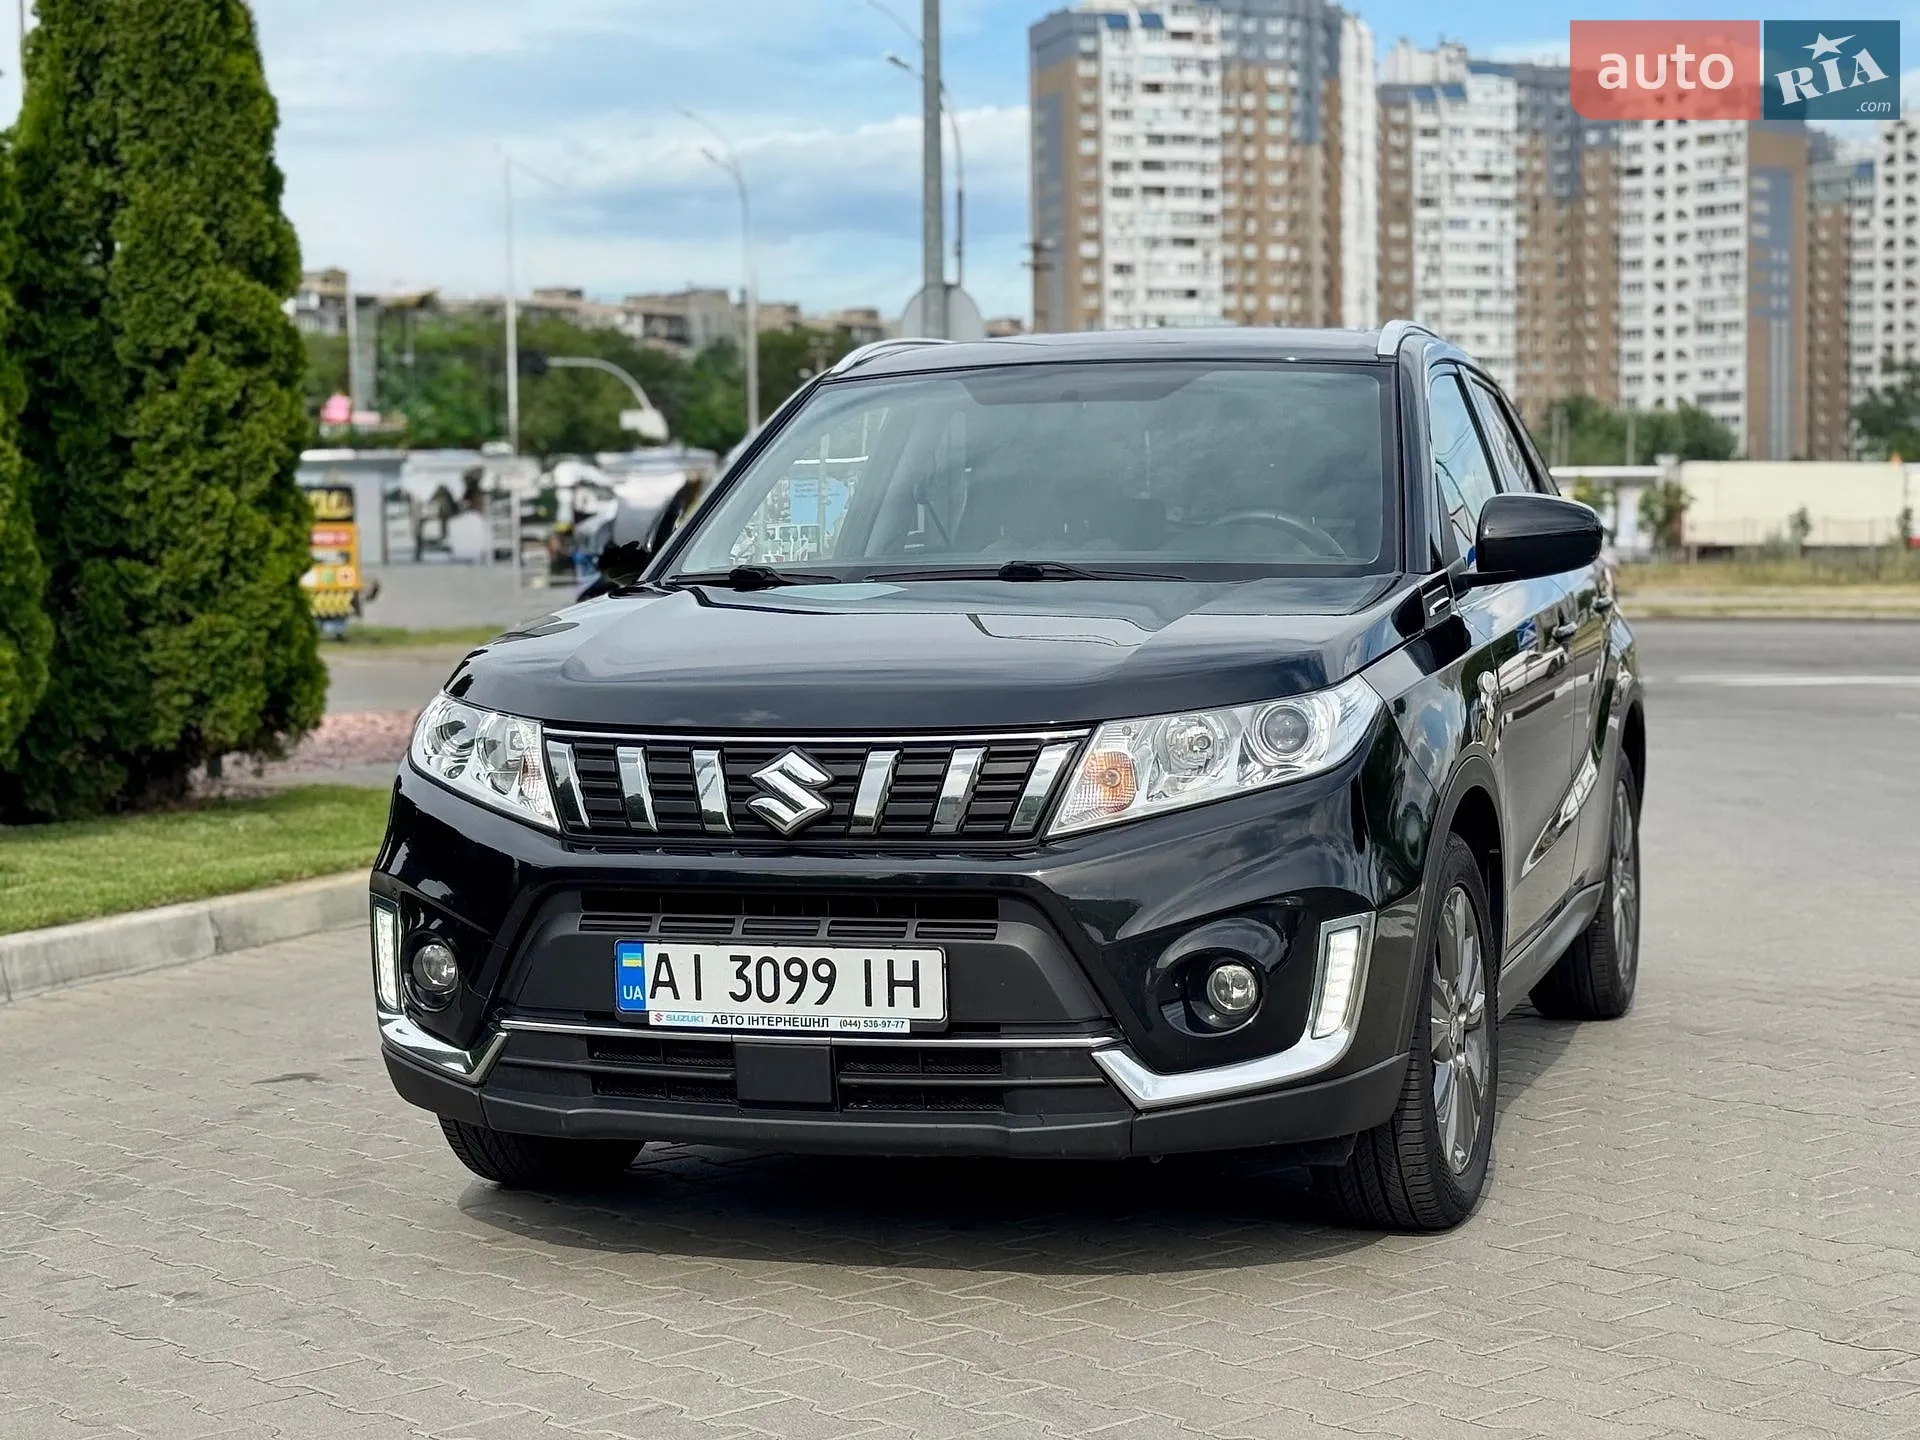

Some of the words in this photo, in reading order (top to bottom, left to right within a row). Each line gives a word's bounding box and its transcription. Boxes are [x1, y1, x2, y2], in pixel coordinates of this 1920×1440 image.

[649, 952, 702, 1001] AI
[728, 954, 838, 1006] 3099
[863, 958, 921, 1009] IH
[623, 985, 644, 1001] UA
[665, 1013, 704, 1023] SUZUKI
[711, 1014, 745, 1026] АВТО
[839, 1019, 861, 1030] (044)
[863, 1019, 906, 1030] 536-97-77
